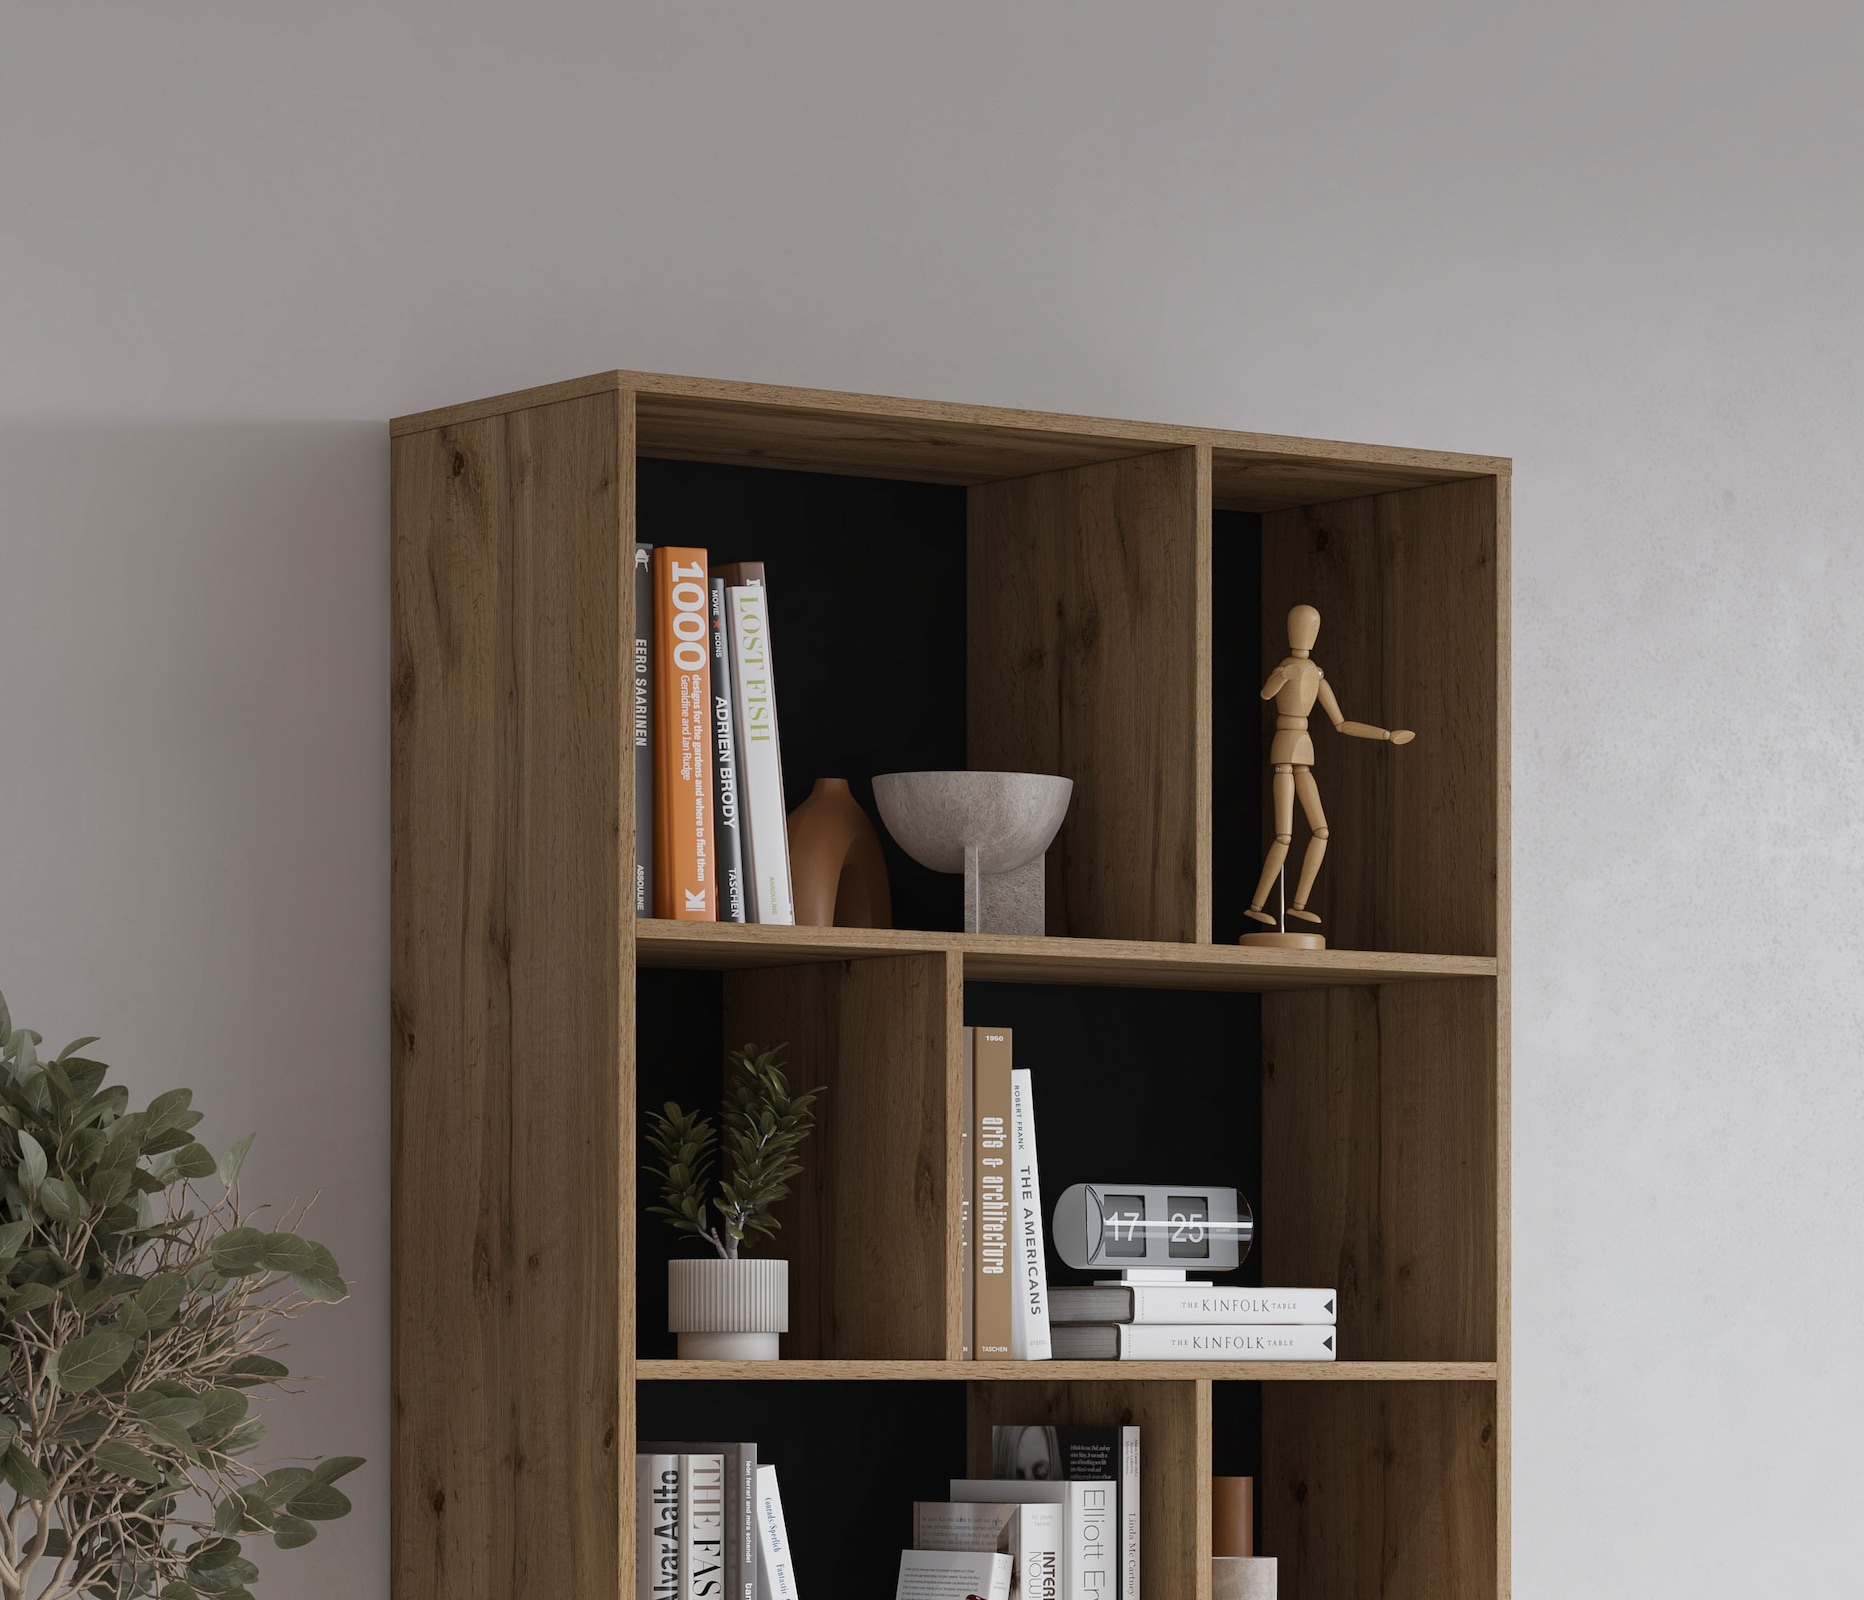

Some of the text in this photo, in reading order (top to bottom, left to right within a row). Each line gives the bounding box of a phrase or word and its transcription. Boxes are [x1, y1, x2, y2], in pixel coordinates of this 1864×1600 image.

[711, 589, 722, 658] MOVIE ICONS
[739, 597, 764, 670] LOST
[636, 639, 647, 747] EERO SAARINEN
[671, 561, 707, 881] 1000 designs for the gardens and where to find them
[746, 679, 770, 741] FISH
[680, 675, 692, 781] Geraldine and Ian Rudge
[715, 696, 735, 829] ADRIEN BRODY
[637, 864, 645, 911] ASSOULINE
[728, 867, 740, 918] TASCHEN
[769, 876, 778, 916] ASSOULINE
[982, 1117, 1007, 1148] arts
[1014, 1085, 1025, 1150] ROBERT FRANK
[982, 1176, 1009, 1274] architecture
[1020, 1165, 1041, 1315] THE AMERICANS
[1108, 1211, 1205, 1243] 17 25
[1202, 1299, 1270, 1312] KINFOLK
[1192, 1336, 1266, 1350] KINFOLK
[653, 1470, 679, 1541] Aalto
[693, 1459, 721, 1530] THE
[1083, 1490, 1105, 1559] Elliott
[1128, 1512, 1137, 1540] Linda
[775, 1563, 788, 1596] Fantastic
[1028, 1551, 1042, 1599] NOW!
